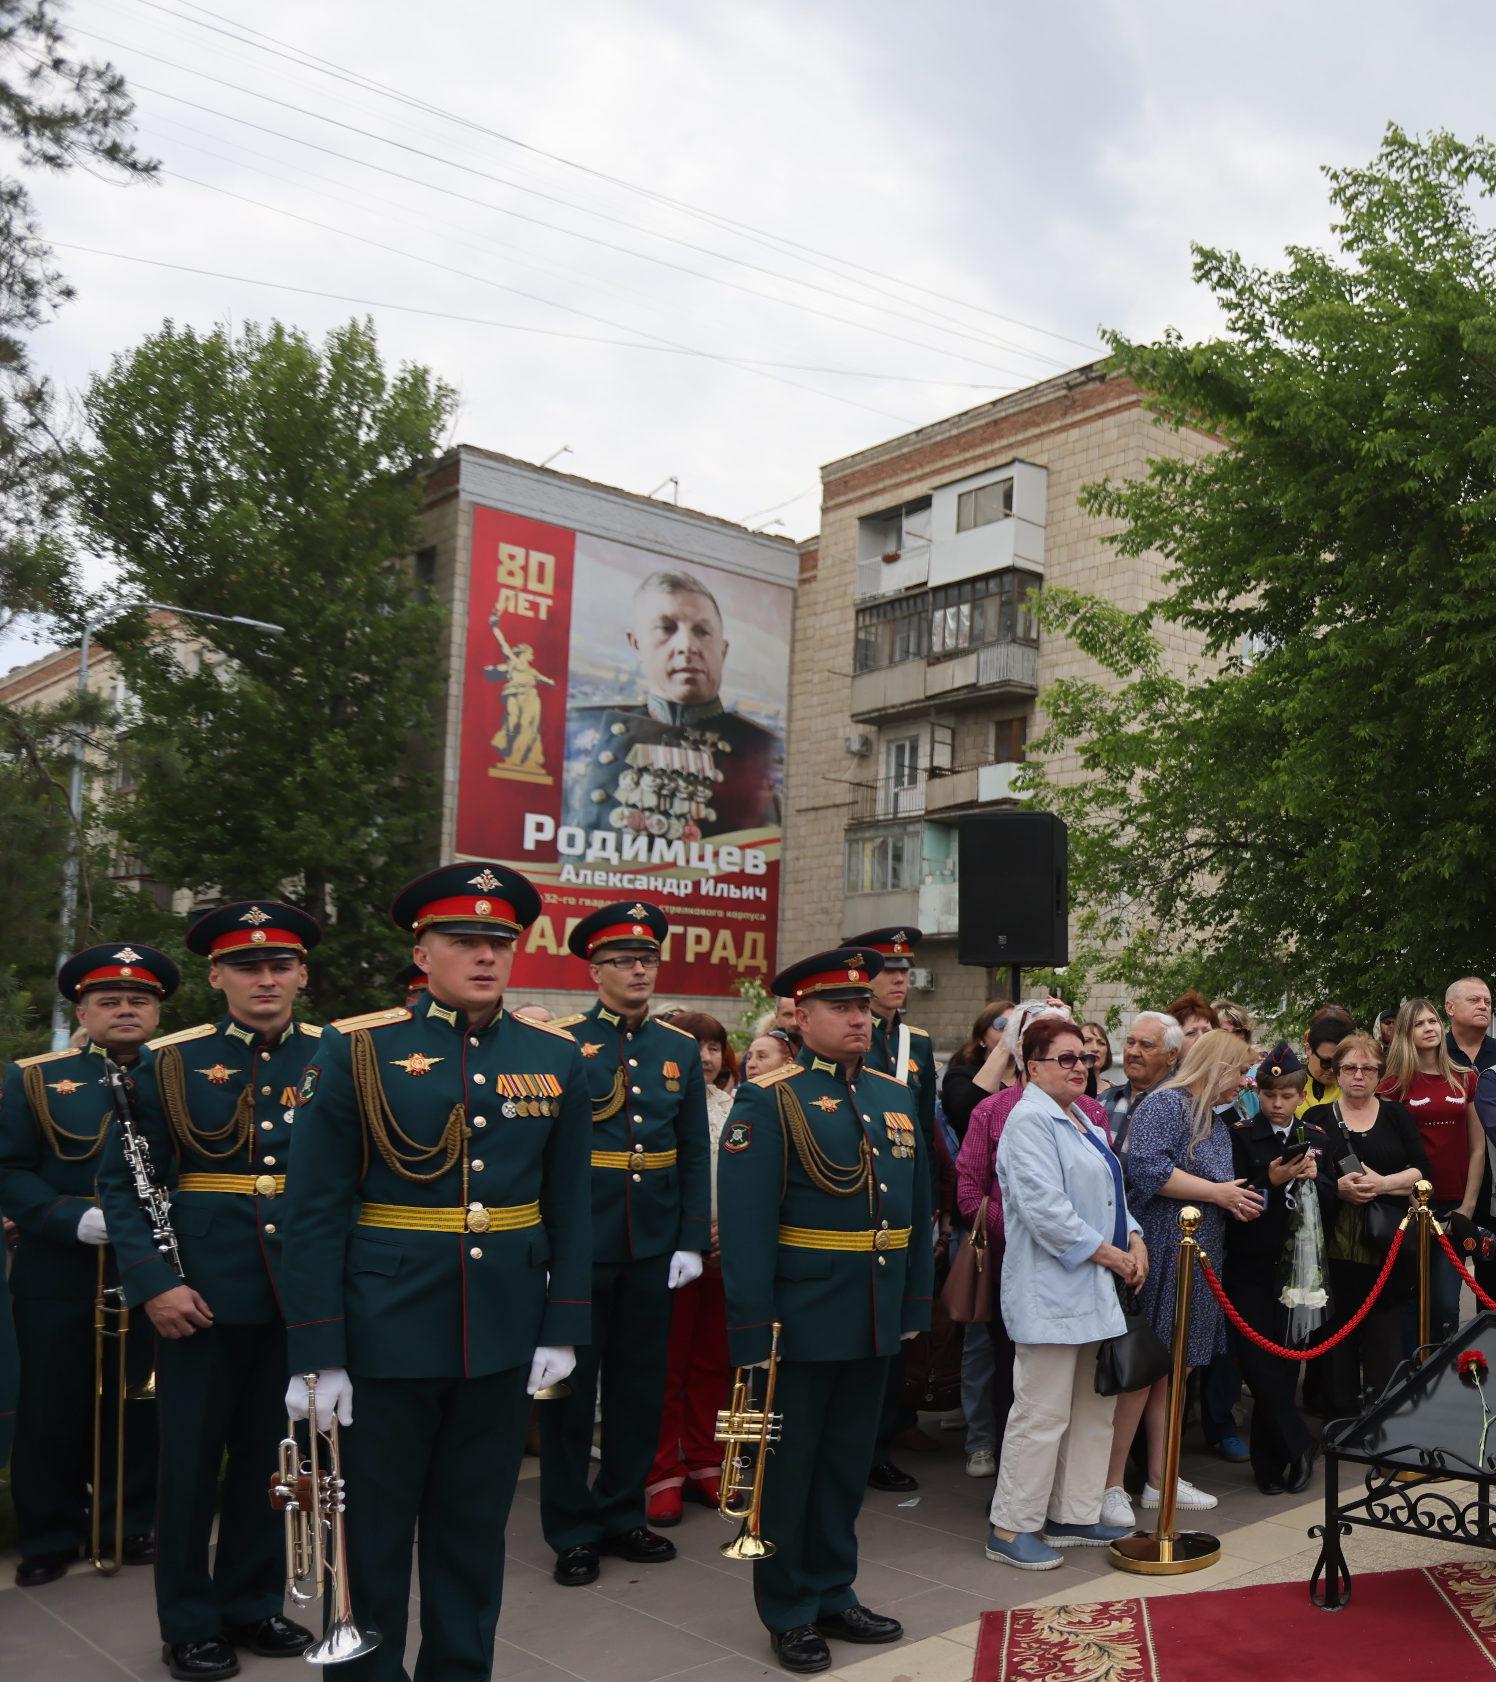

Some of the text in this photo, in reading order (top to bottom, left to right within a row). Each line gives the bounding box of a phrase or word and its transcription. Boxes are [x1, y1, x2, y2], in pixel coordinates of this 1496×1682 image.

[497, 542, 556, 595] 80
[496, 588, 553, 620] ЛЕТ
[523, 813, 767, 875] Родимцев
[560, 864, 767, 901] Александр Ильич
[726, 910, 766, 922] корпуса
